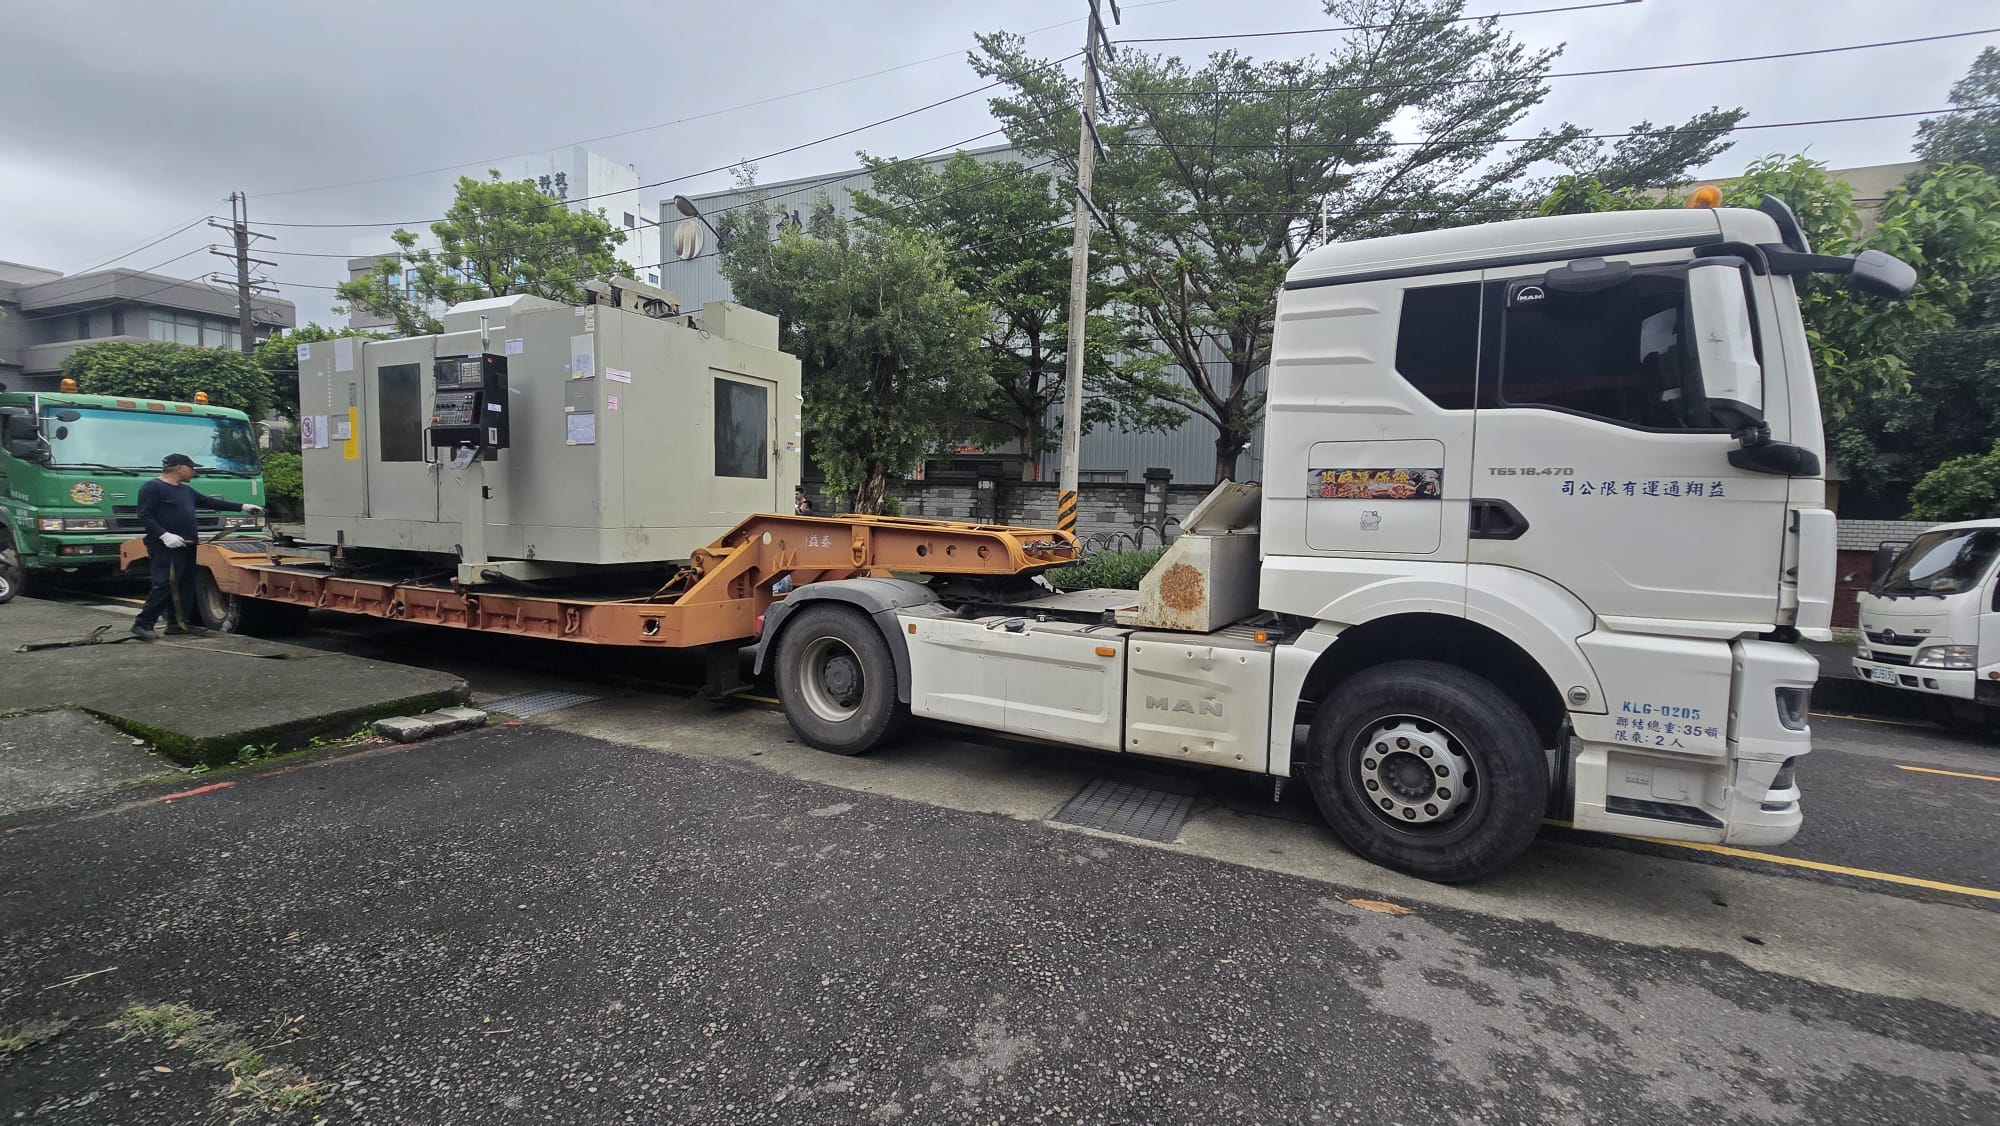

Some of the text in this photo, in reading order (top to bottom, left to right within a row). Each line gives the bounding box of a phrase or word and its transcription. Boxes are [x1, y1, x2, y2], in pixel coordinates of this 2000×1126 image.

[1488, 467, 1574, 476] TGS 18.470
[1146, 696, 1223, 717] MAN
[1622, 700, 1701, 721] KLG-0205
